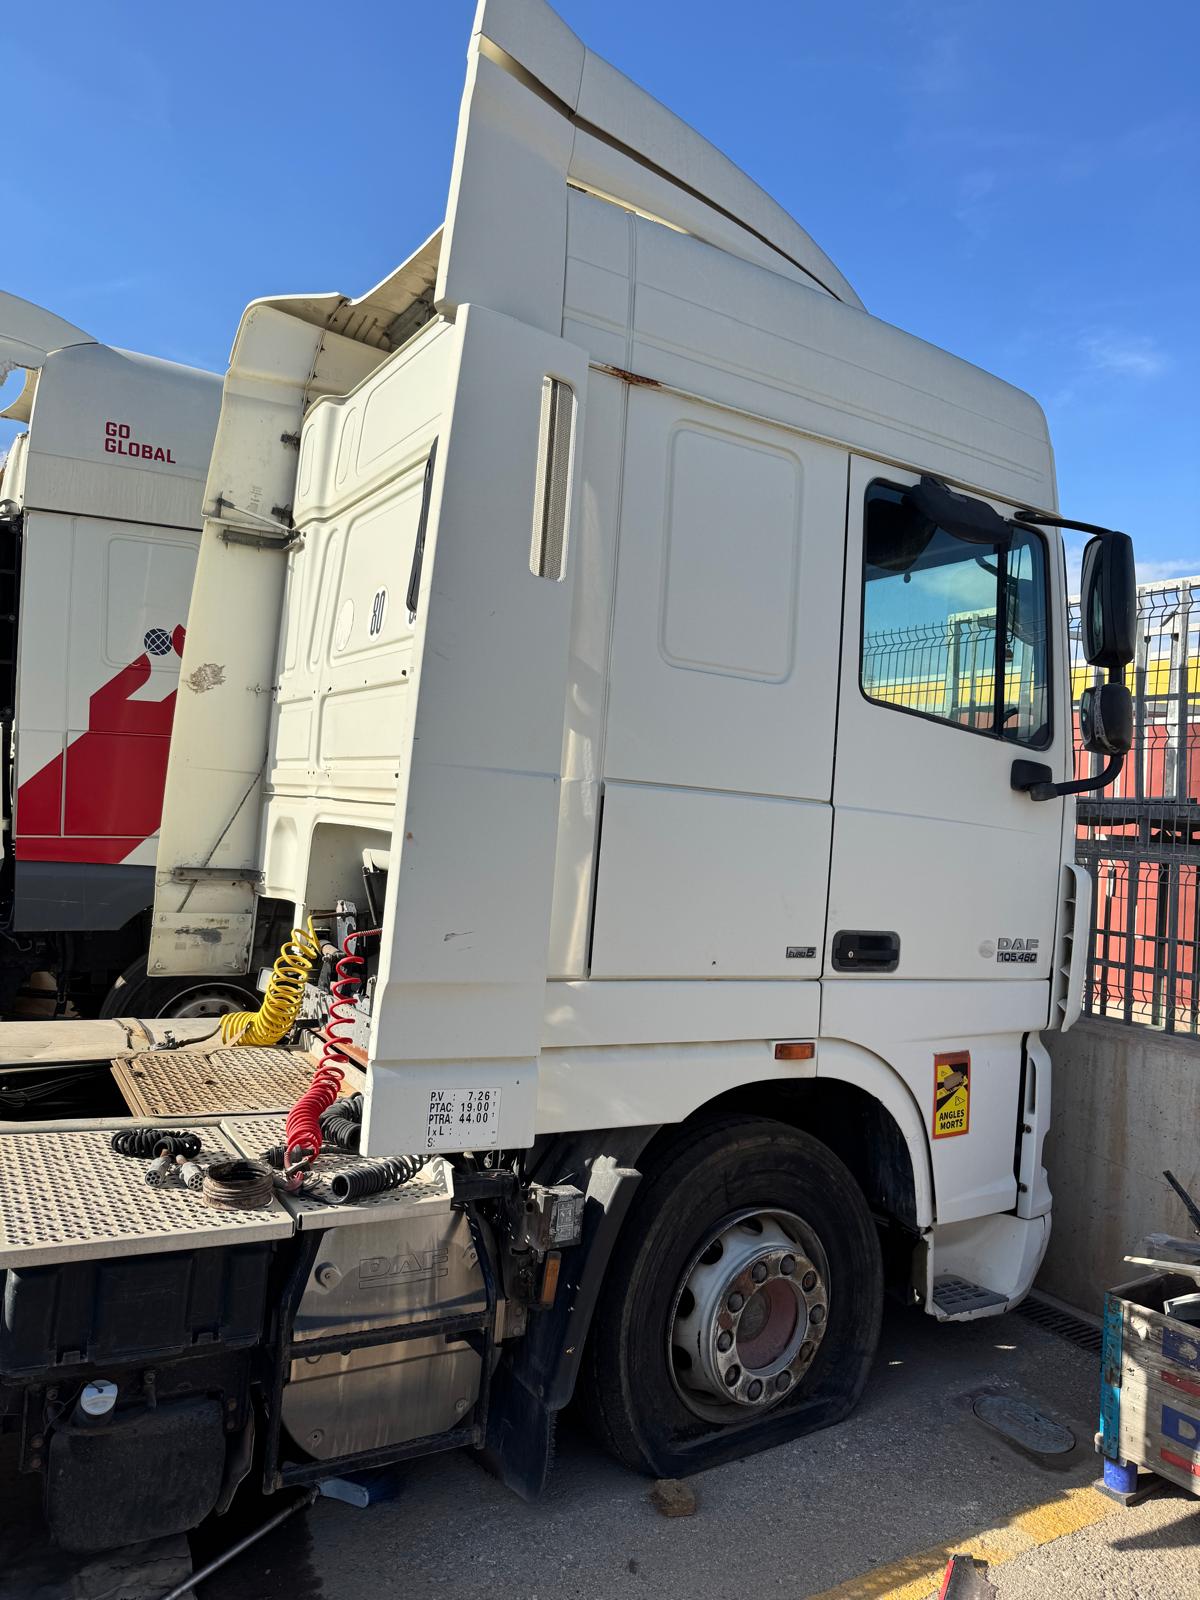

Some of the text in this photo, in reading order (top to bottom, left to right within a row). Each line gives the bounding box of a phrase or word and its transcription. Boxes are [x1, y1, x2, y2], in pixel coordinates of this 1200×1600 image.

[105, 421, 130, 439] GO
[104, 437, 176, 464] GLOBAL
[370, 590, 386, 636] 80
[997, 937, 1040, 951] DAF
[468, 1091, 490, 1102] 7,26
[429, 1102, 454, 1113] PTAC:
[428, 1113, 453, 1125] PTRA:
[939, 1109, 965, 1121] ANGLES
[940, 1119, 963, 1130] MORTS
[359, 1248, 449, 1279] DAF
